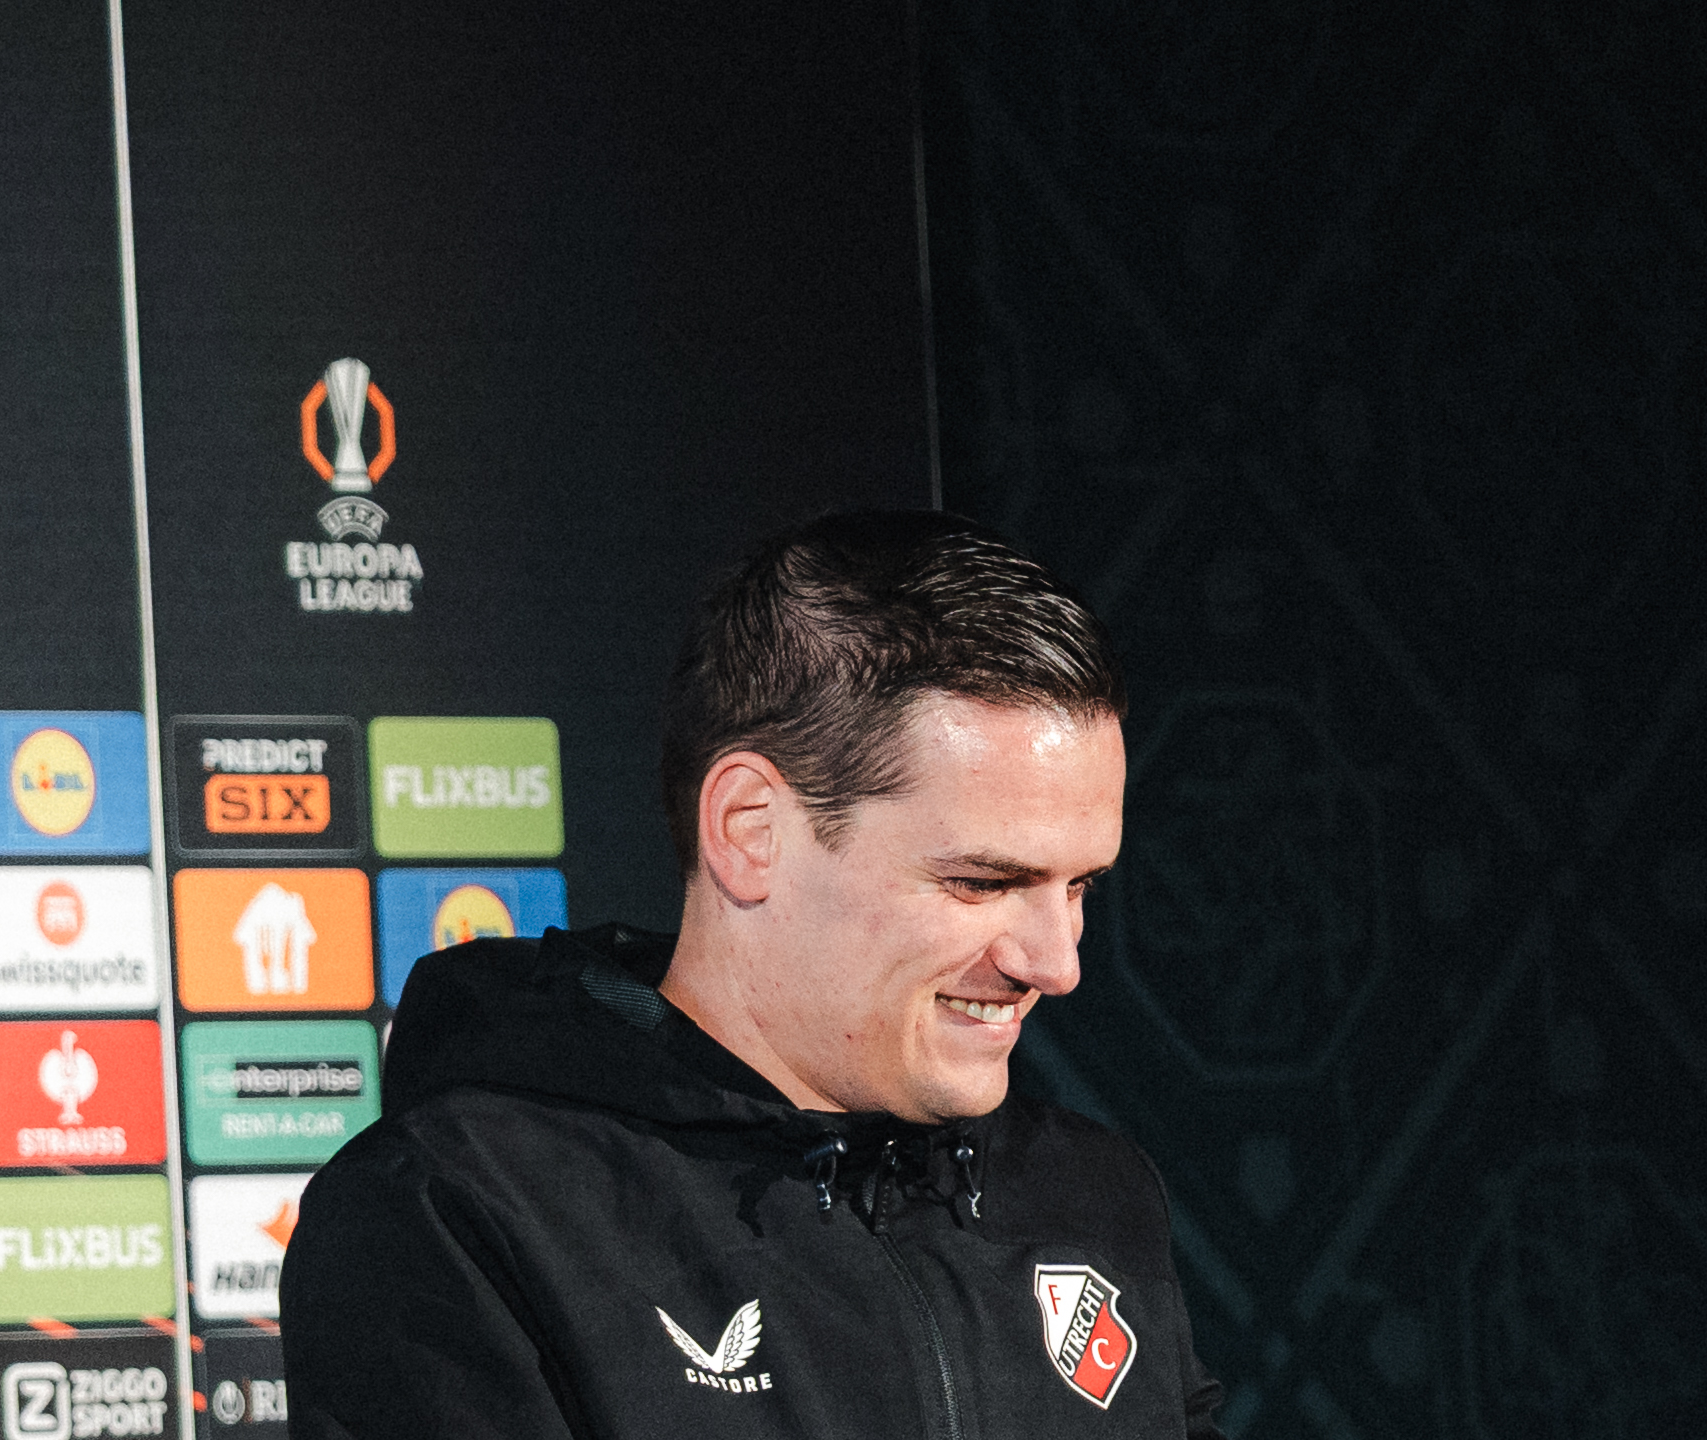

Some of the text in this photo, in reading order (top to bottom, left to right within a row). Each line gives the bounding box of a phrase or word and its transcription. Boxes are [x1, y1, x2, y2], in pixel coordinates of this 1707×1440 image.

[285, 541, 424, 580] EUROPA
[298, 578, 414, 612] LEAGUE
[201, 738, 329, 774] PREDICT
[220, 786, 315, 822] SIX
[210, 1061, 364, 1099] enterprise
[17, 1127, 128, 1157] STRAUSS
[1058, 1279, 1105, 1378] UTRECHT
[71, 1366, 168, 1402] ZIGGO
[685, 1366, 774, 1395] CASTORE
[72, 1402, 167, 1436] SPORT
